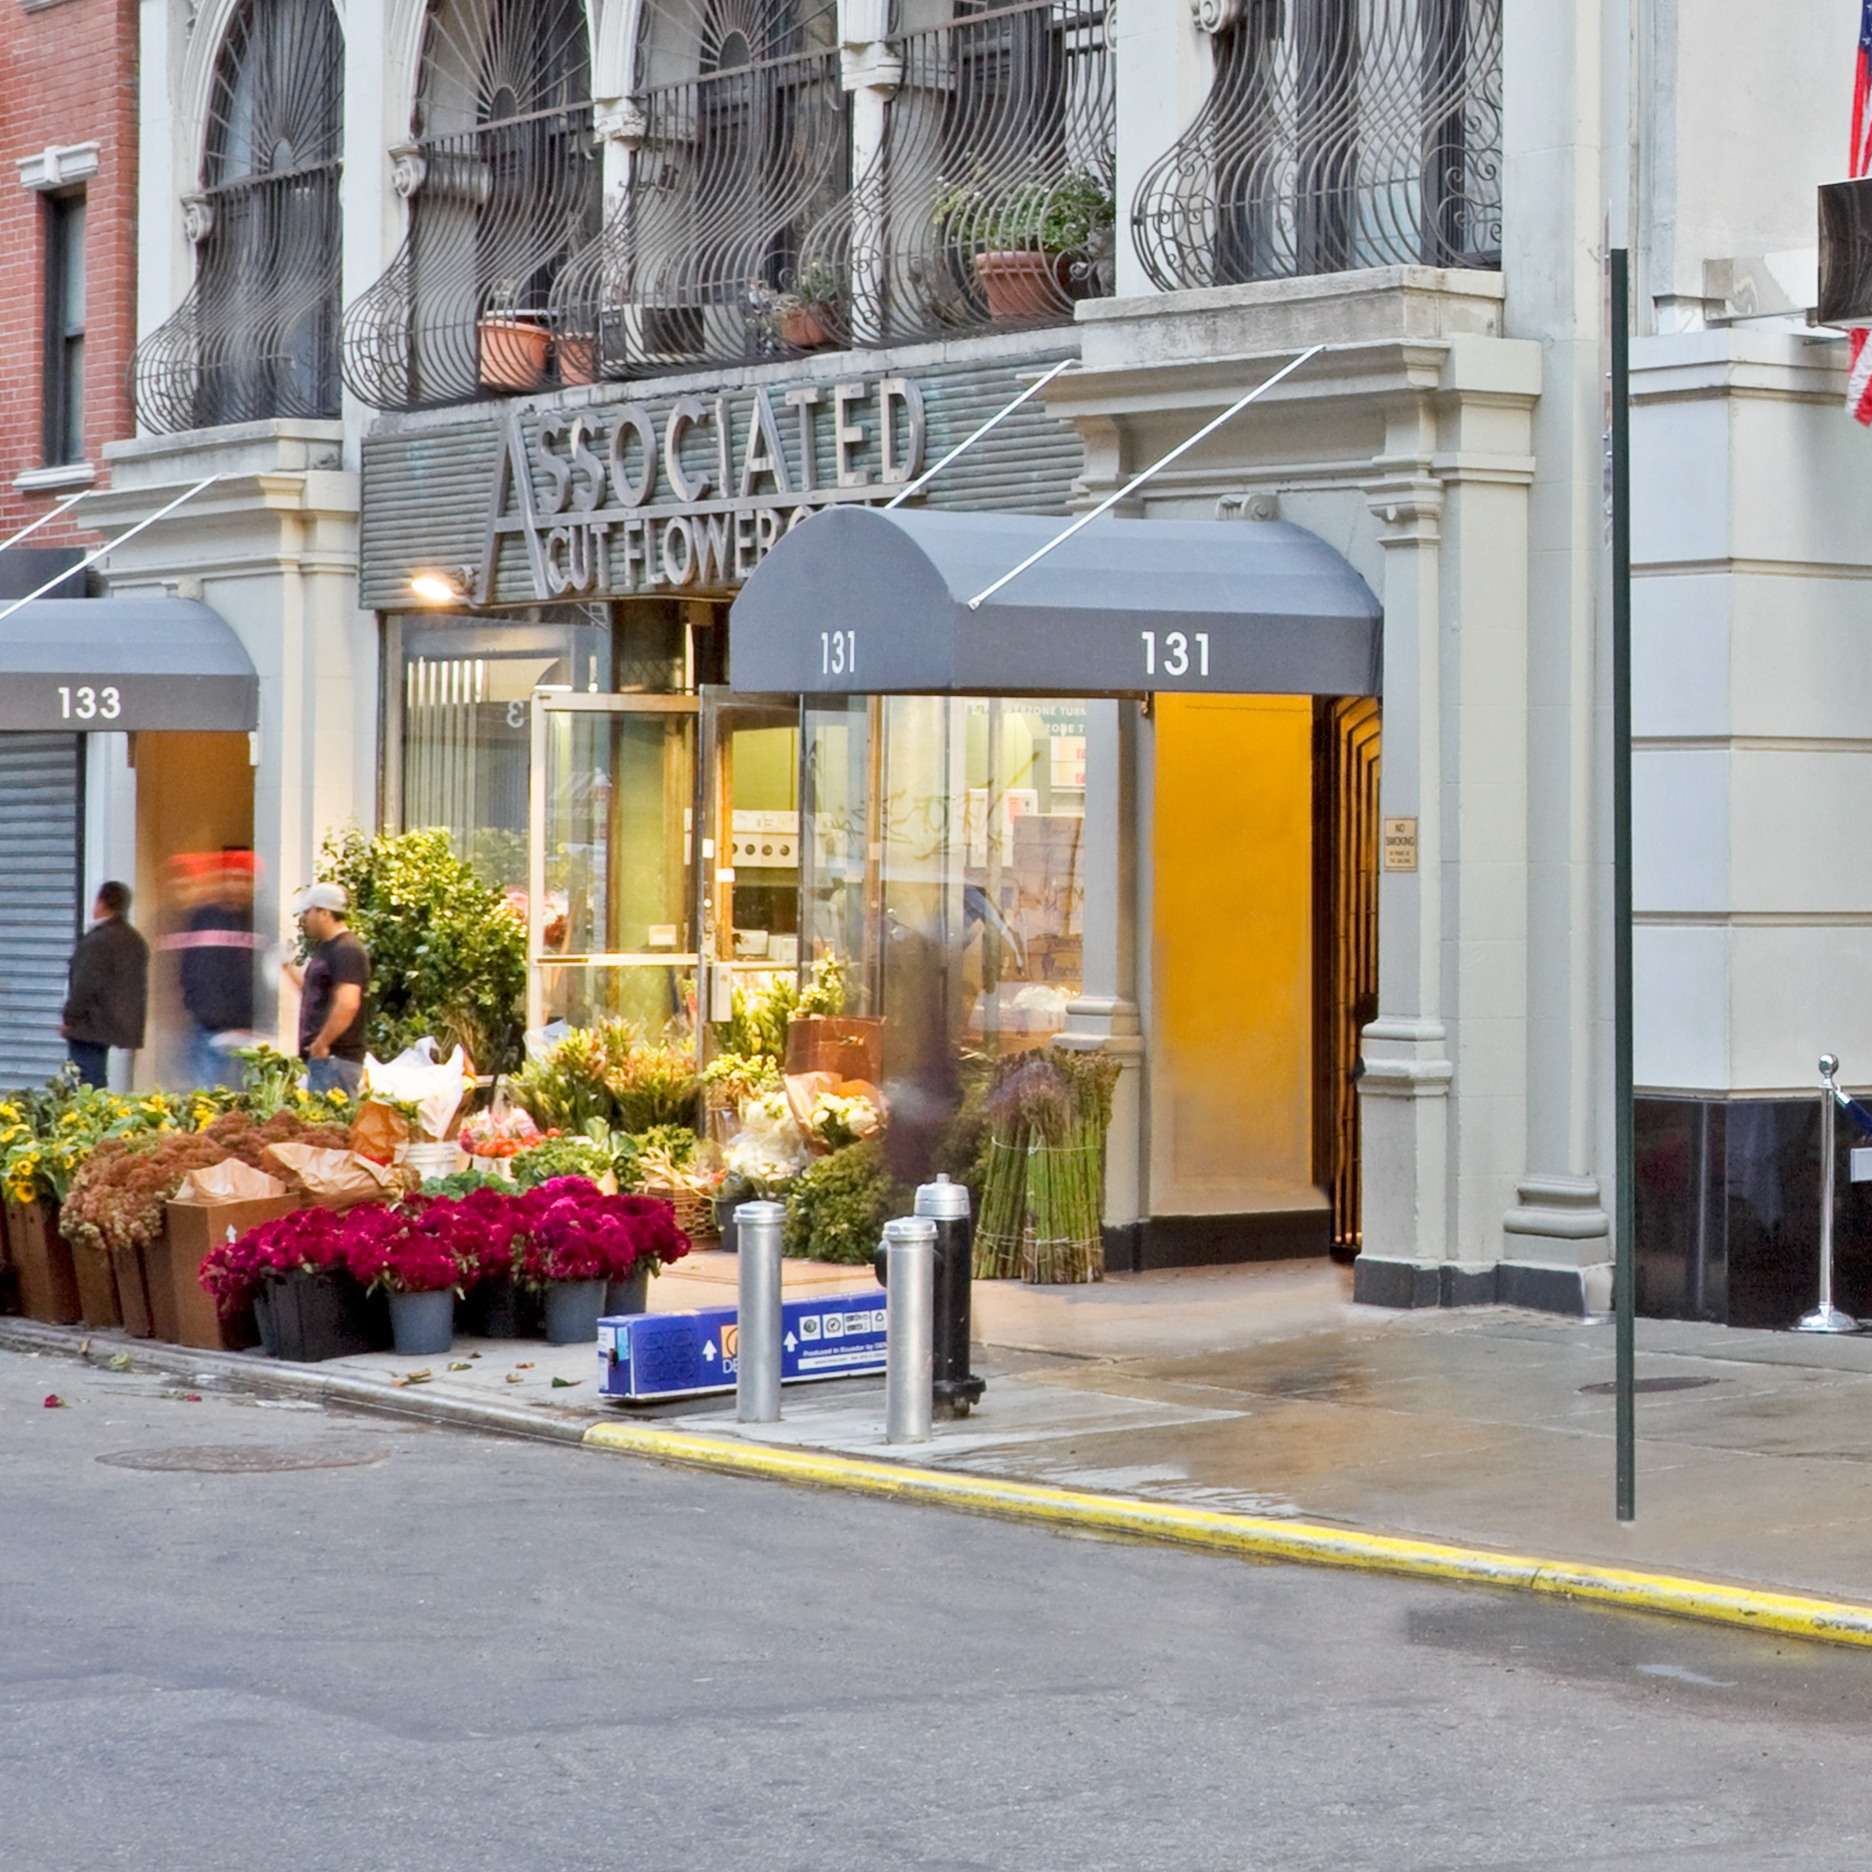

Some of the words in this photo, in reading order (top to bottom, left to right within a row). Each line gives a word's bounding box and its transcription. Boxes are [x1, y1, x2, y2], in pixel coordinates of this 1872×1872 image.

[476, 377, 927, 606] ASSOCIATED
[546, 521, 611, 595] CUT
[820, 629, 856, 675] 131
[1141, 631, 1209, 676] 131
[57, 686, 121, 719] 133
